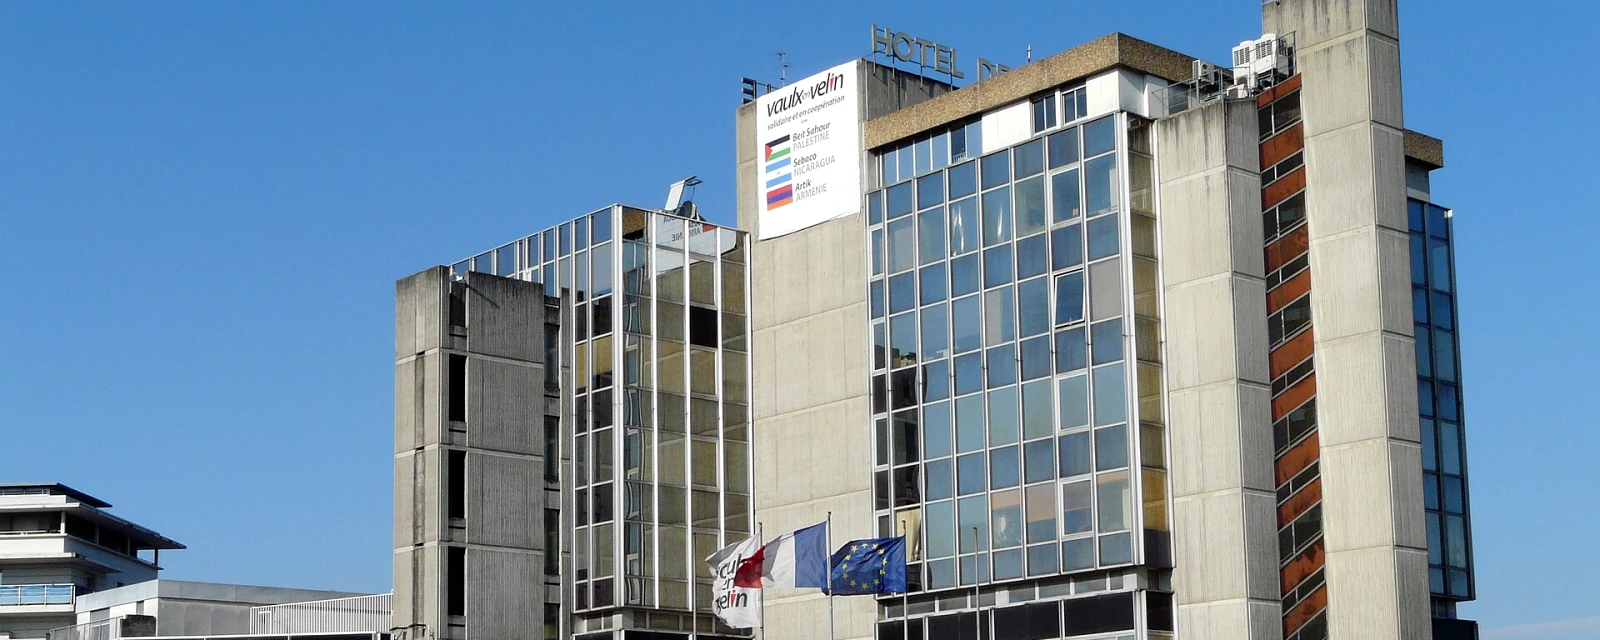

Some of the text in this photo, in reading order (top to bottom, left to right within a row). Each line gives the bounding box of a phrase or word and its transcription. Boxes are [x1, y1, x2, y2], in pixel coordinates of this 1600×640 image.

[871, 24, 1010, 82] HOTEL D
[767, 86, 804, 117] vaulx
[810, 72, 844, 100] velin
[767, 115, 792, 131] solidaire
[792, 112, 799, 121] et
[798, 110, 807, 118] en
[793, 122, 831, 142] Beit Sahour
[793, 130, 830, 152] PALESTINE
[793, 155, 836, 177] NICARAGUA
[795, 178, 812, 192] Artik
